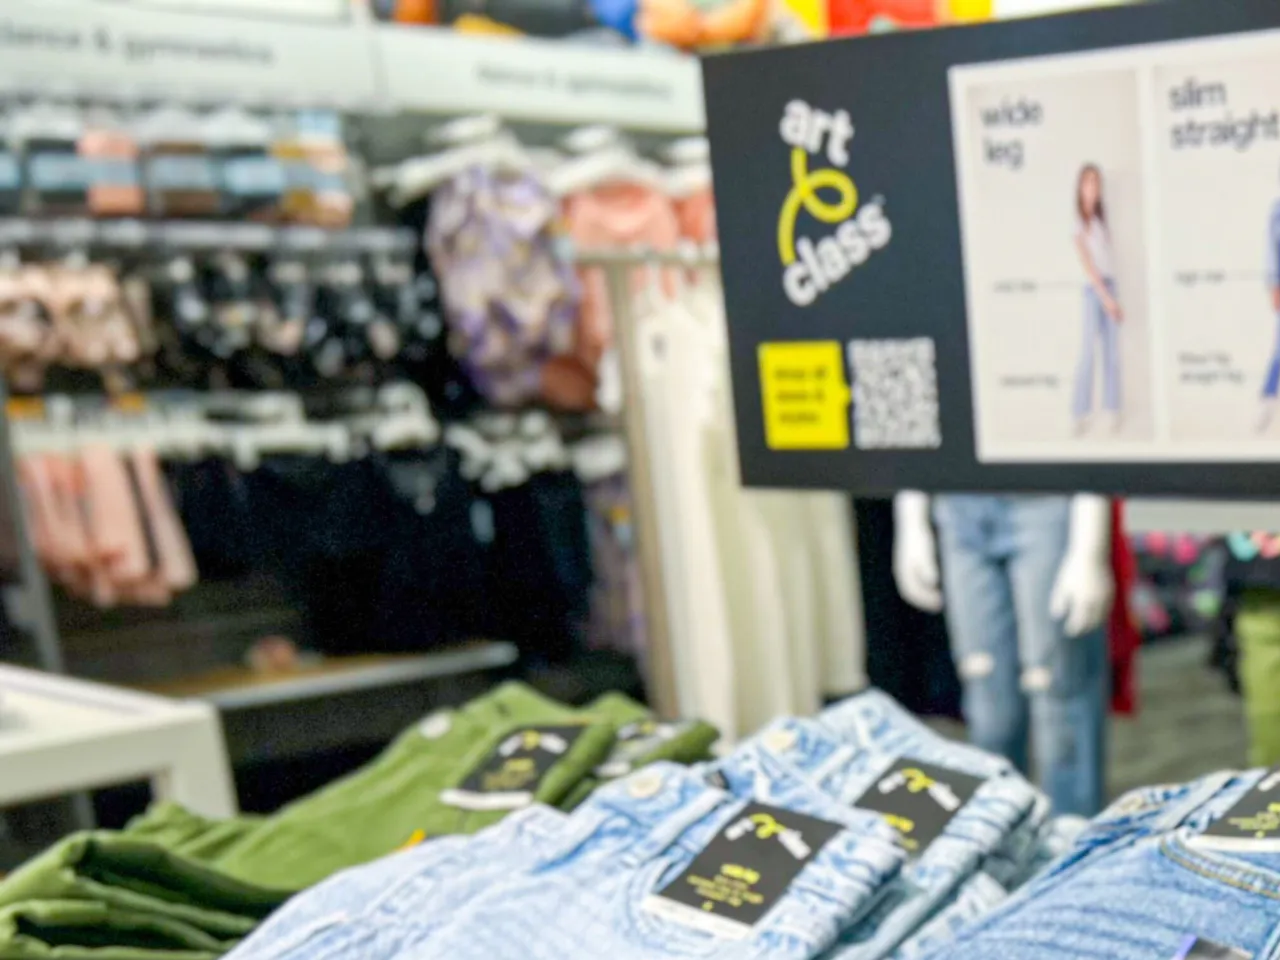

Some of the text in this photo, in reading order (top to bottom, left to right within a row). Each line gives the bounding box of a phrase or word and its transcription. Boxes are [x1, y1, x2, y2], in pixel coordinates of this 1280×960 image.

[1168, 77, 1226, 110] slim
[980, 97, 1043, 128] wide
[780, 100, 853, 167] art
[1170, 112, 1280, 150] straight
[983, 138, 1024, 169] leg
[783, 202, 892, 306] class
